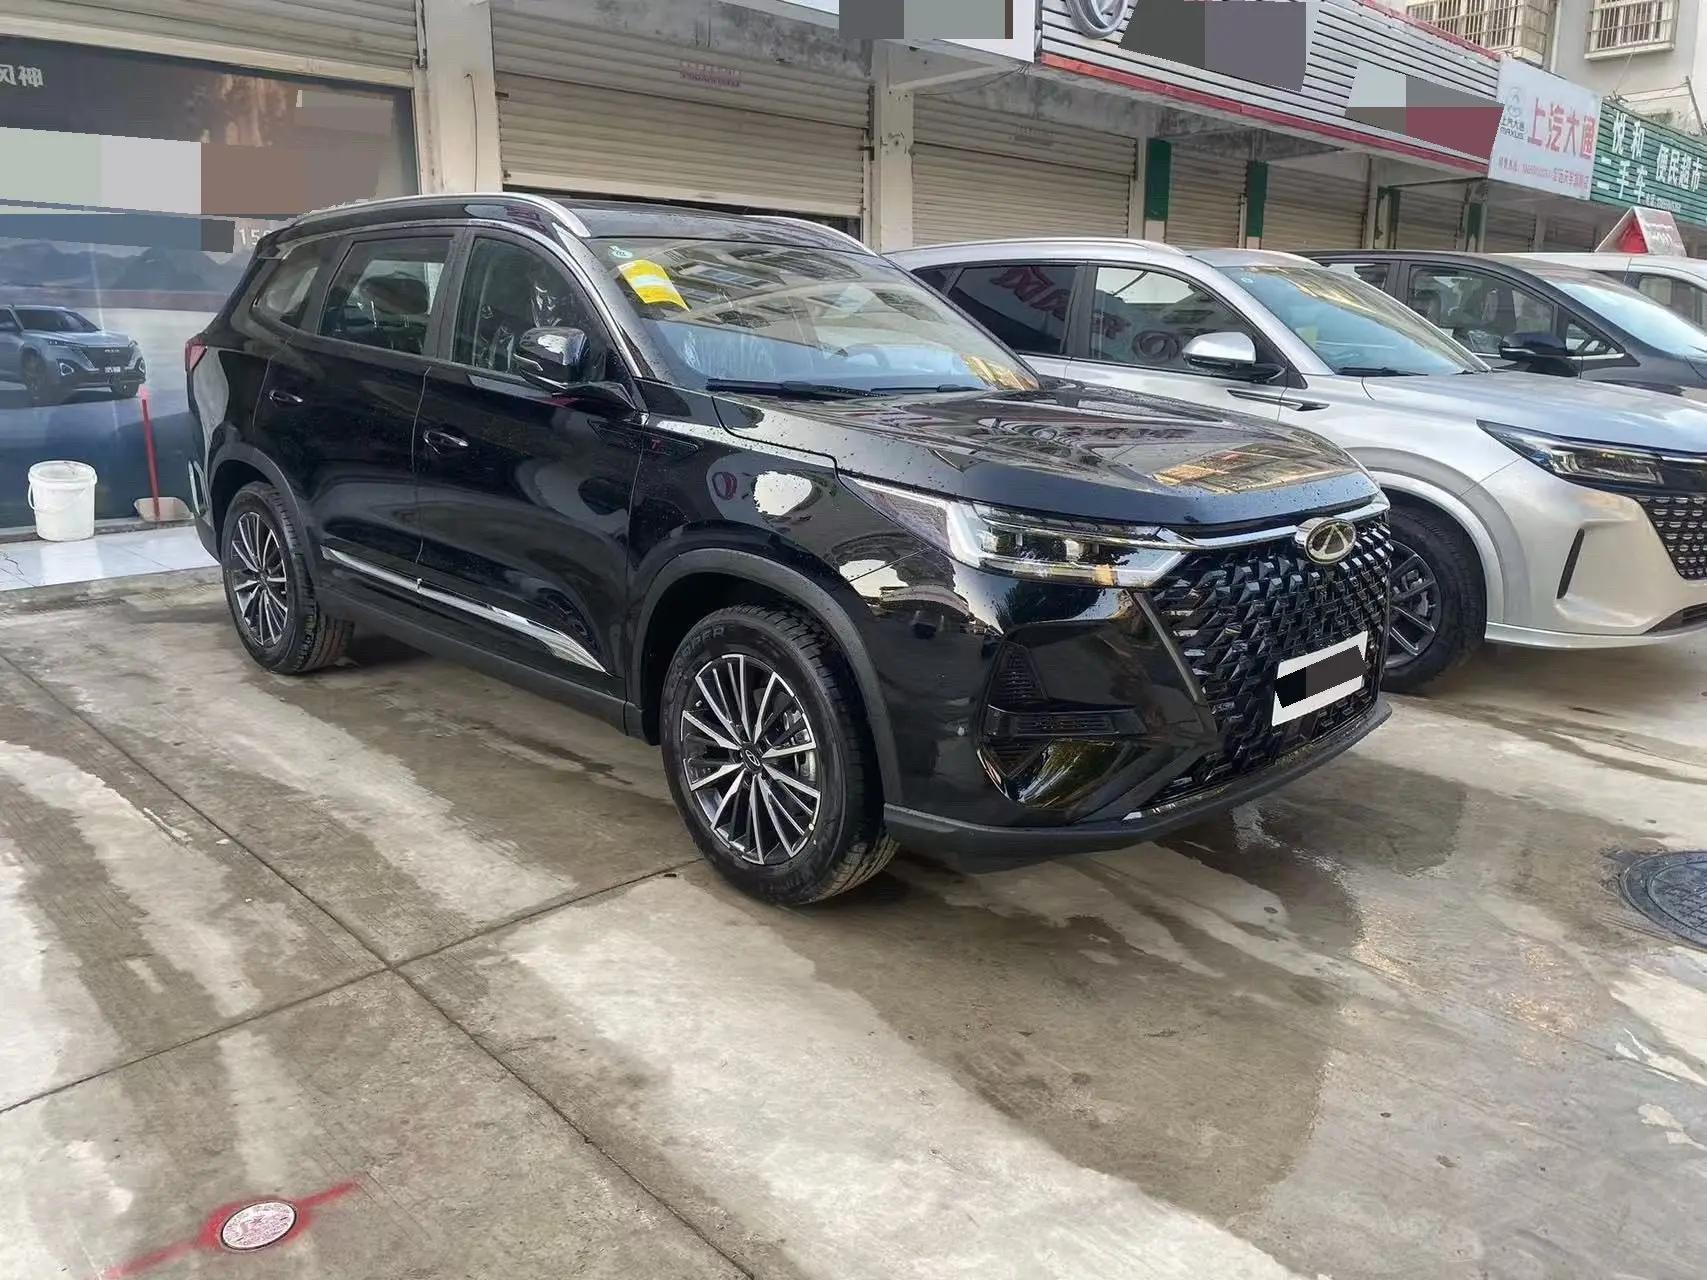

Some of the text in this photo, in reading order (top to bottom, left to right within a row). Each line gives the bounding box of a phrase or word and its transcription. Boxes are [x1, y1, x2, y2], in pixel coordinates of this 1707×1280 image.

[1527, 96, 1597, 160] 上汽大通
[1655, 143, 1704, 192] 便民超市
